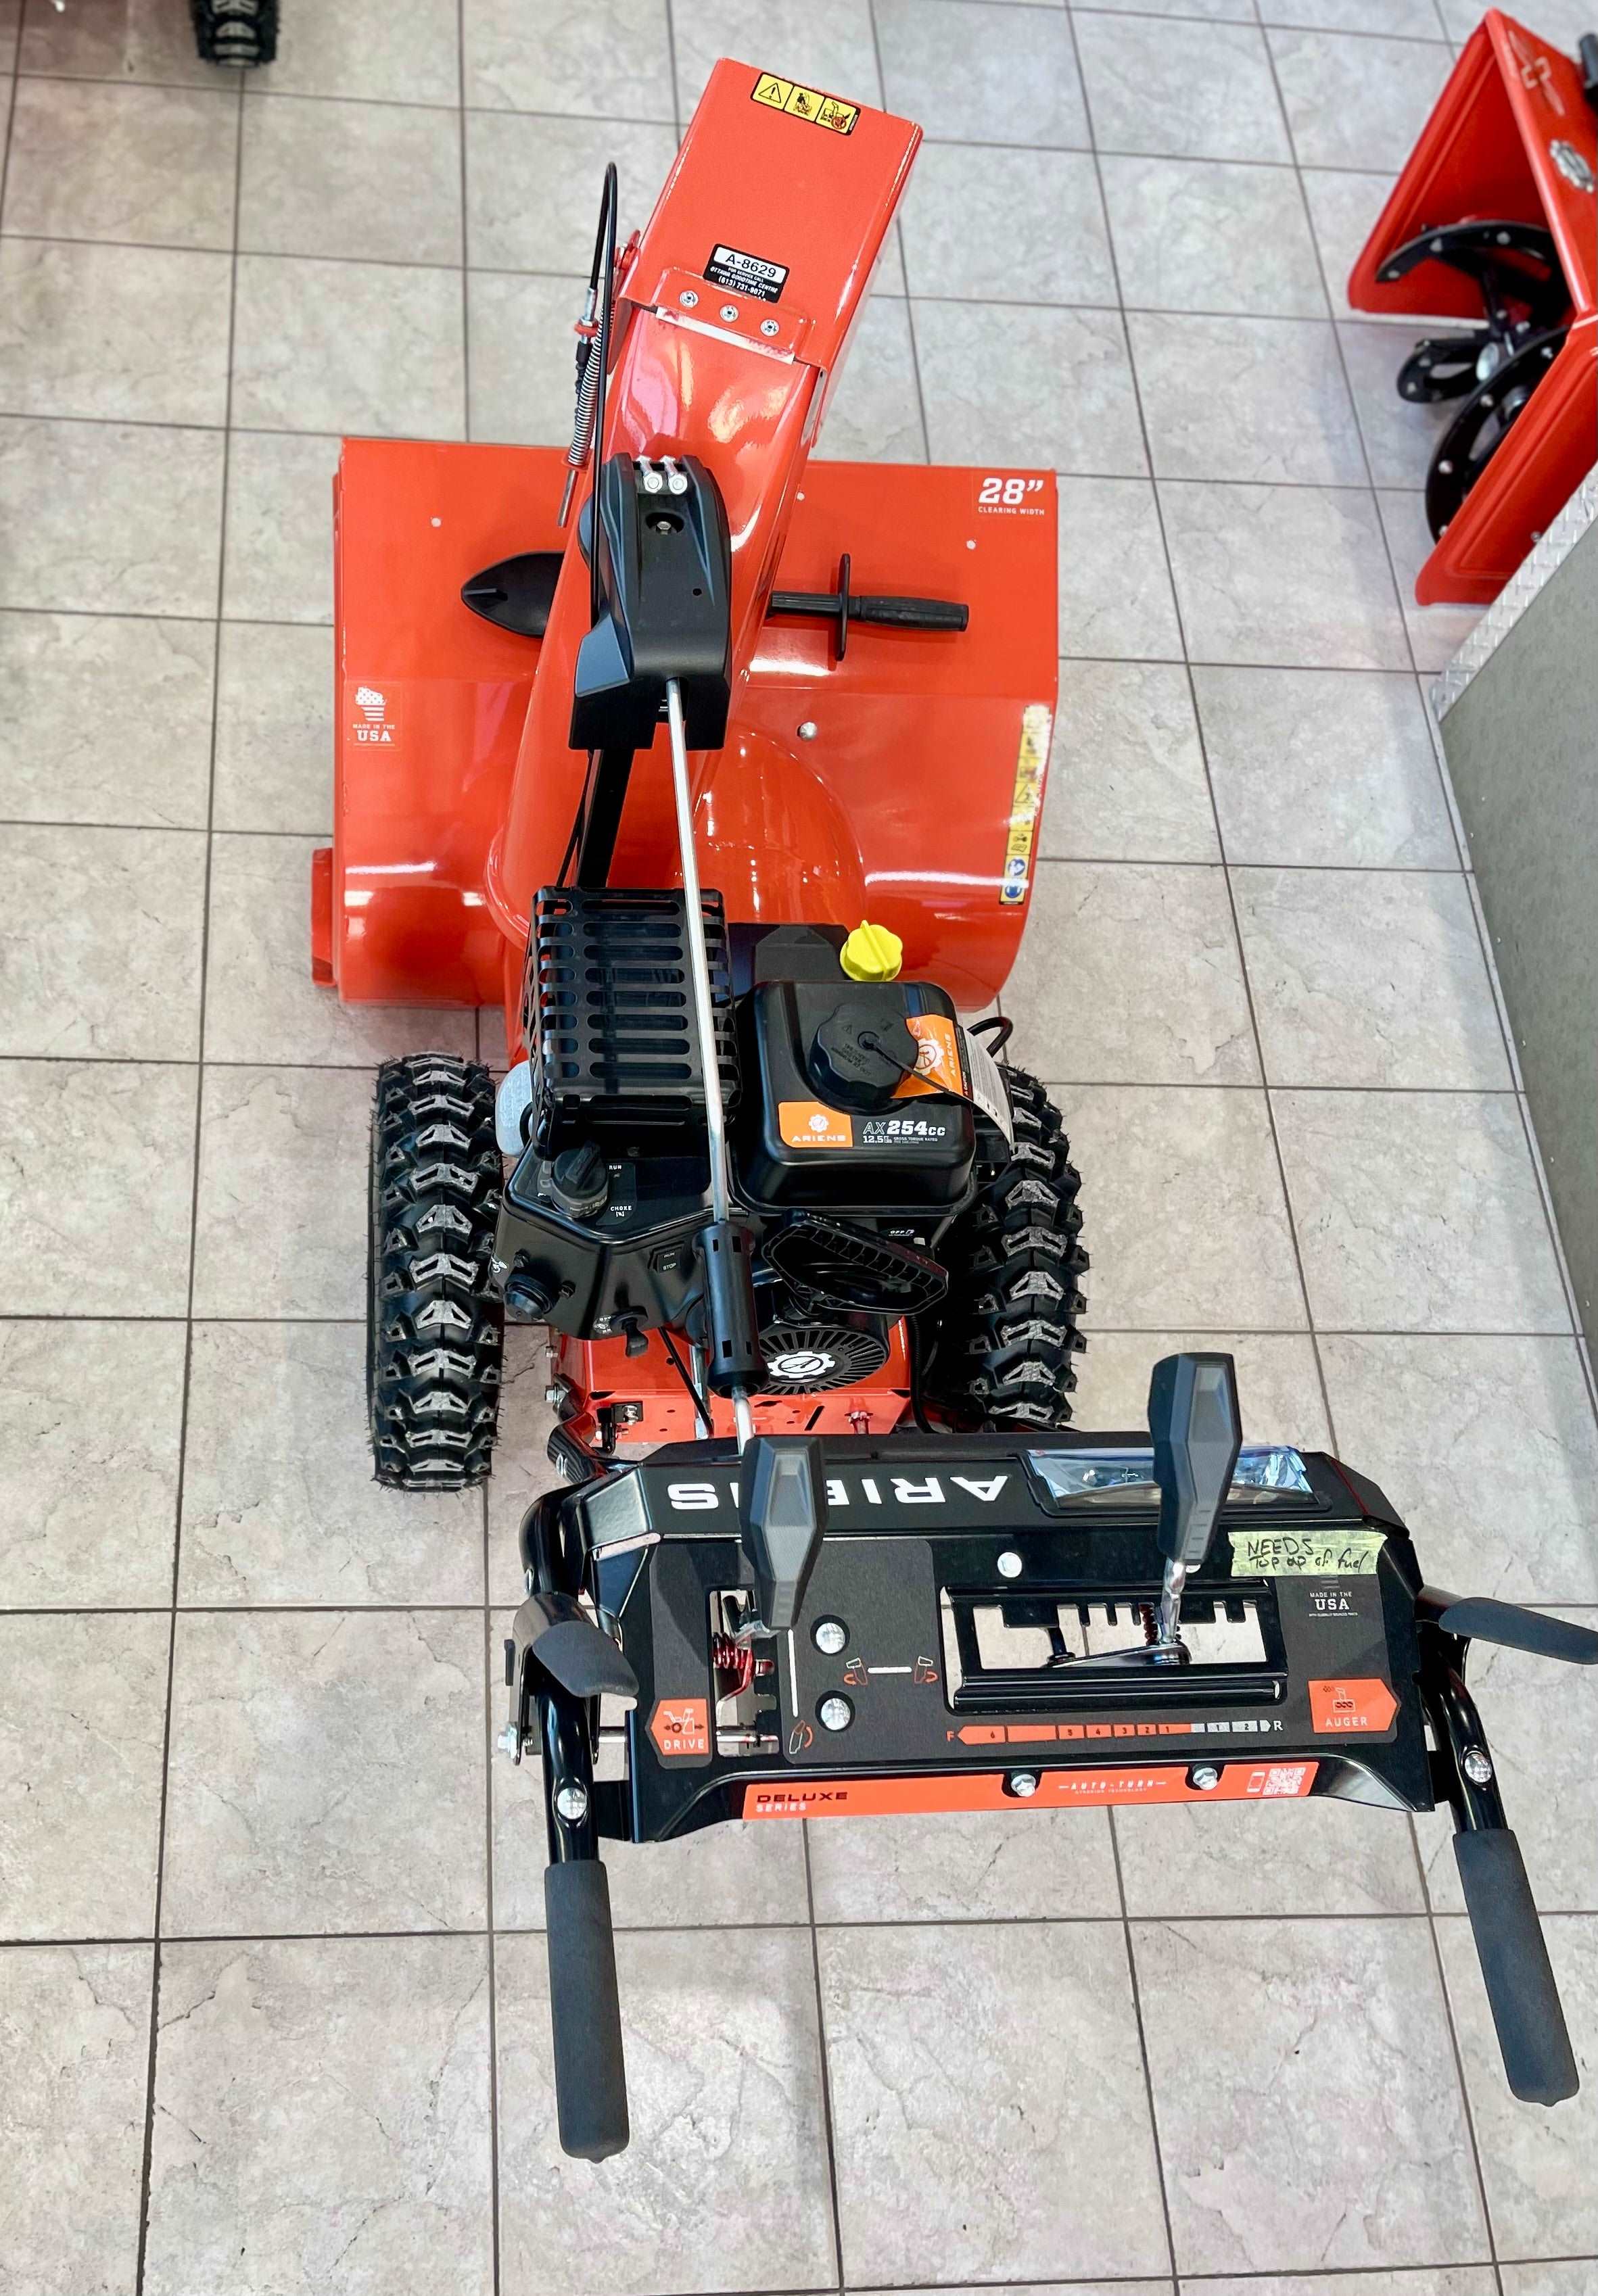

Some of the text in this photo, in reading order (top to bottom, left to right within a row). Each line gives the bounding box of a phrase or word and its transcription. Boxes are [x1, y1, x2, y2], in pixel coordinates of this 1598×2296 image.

[725, 254, 776, 278] A-8629
[718, 275, 736, 287] (613)
[357, 730, 392, 742] USA
[944, 1033, 956, 1078] ARIENS
[663, 1262, 676, 1270] STOP
[1248, 1537, 1314, 1556] NEEDS
[1315, 1548, 1332, 1567] of
[1338, 1548, 1369, 1573] fuel
[1315, 1598, 1350, 1610] USA
[1325, 1717, 1368, 1727] AUGER
[946, 1730, 955, 1742] F
[1273, 1720, 1284, 1731] R
[663, 1738, 705, 1750] DRIVE
[756, 1792, 848, 1802] DELUXE
[755, 1802, 807, 1813] SERIES
